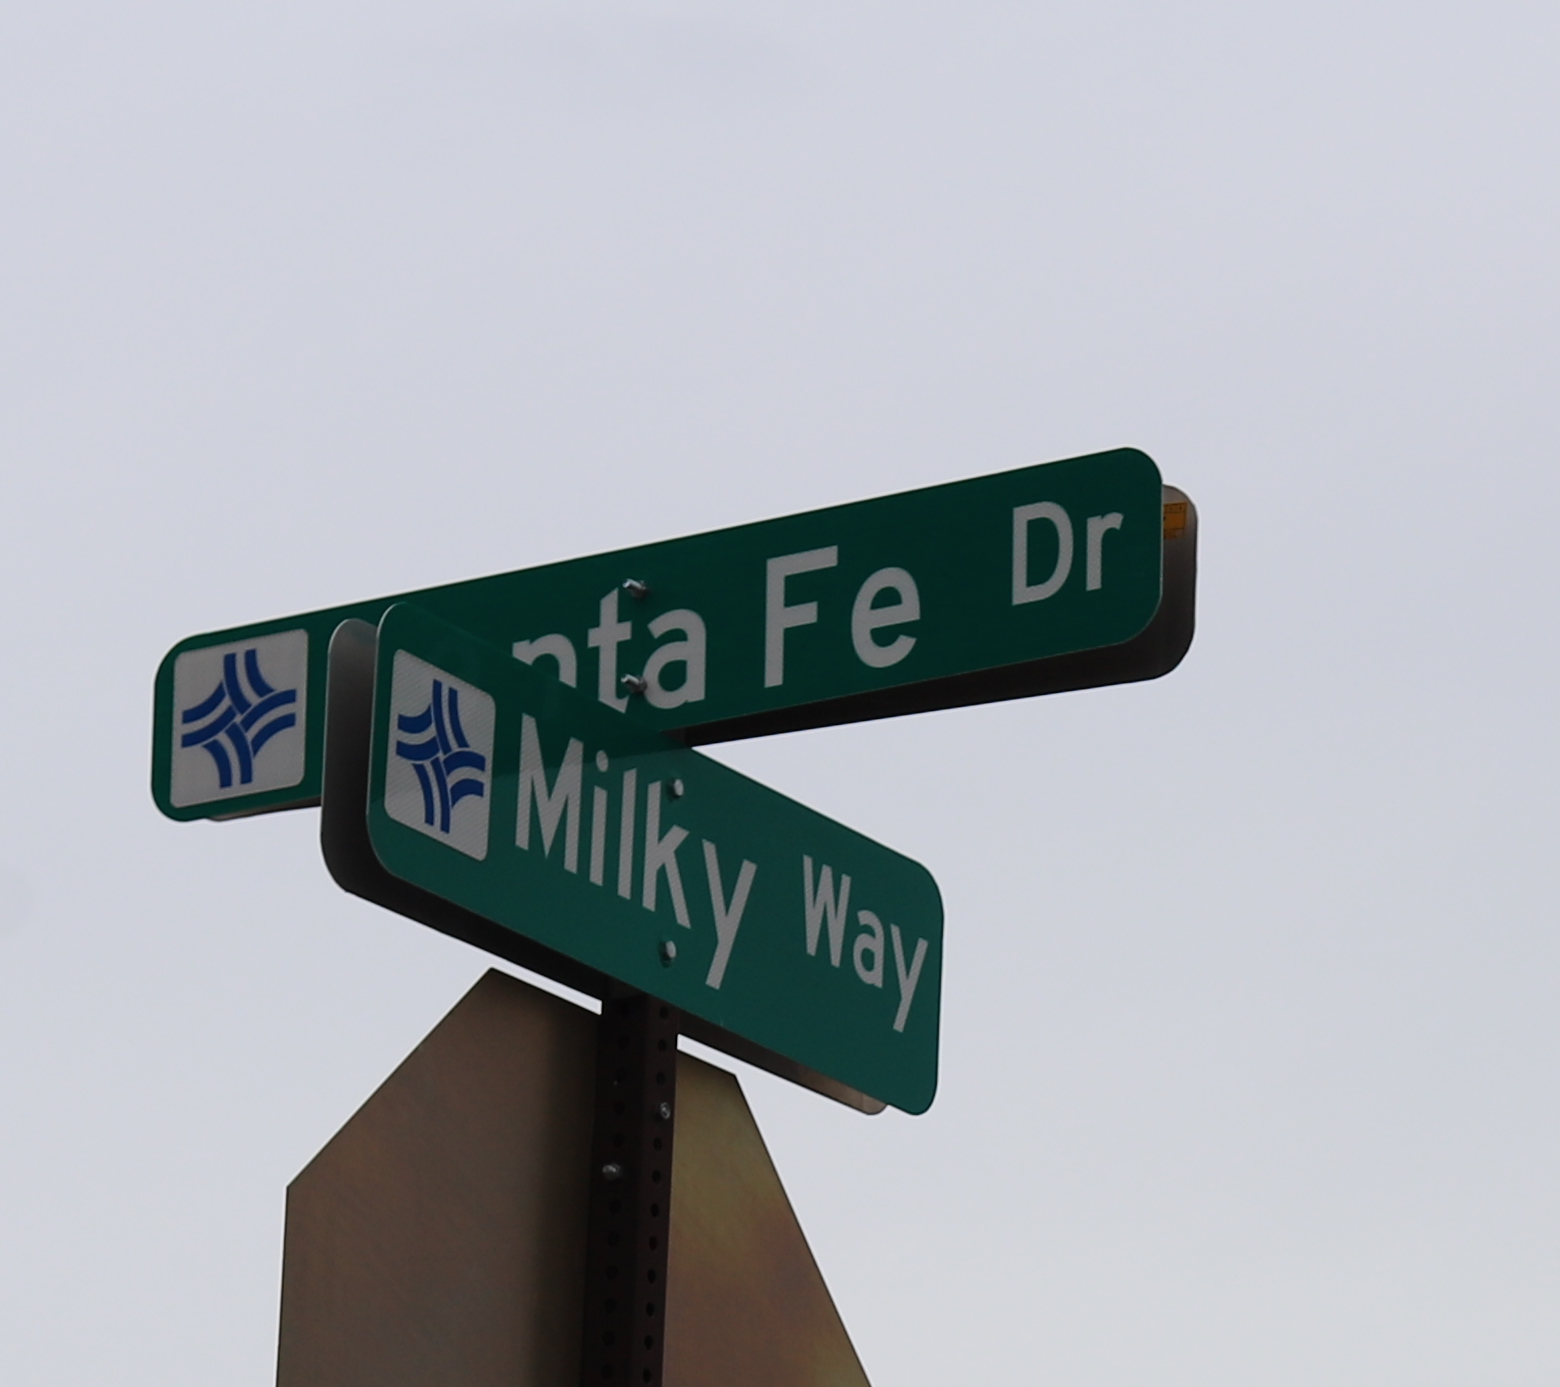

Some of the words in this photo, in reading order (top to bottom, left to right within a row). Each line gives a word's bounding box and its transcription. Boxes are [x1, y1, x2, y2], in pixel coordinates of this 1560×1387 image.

[512, 588, 706, 713] nta
[763, 545, 921, 689] Fe
[1010, 500, 1123, 607] Dr
[515, 714, 757, 990] Milky
[802, 855, 928, 1033] Way
